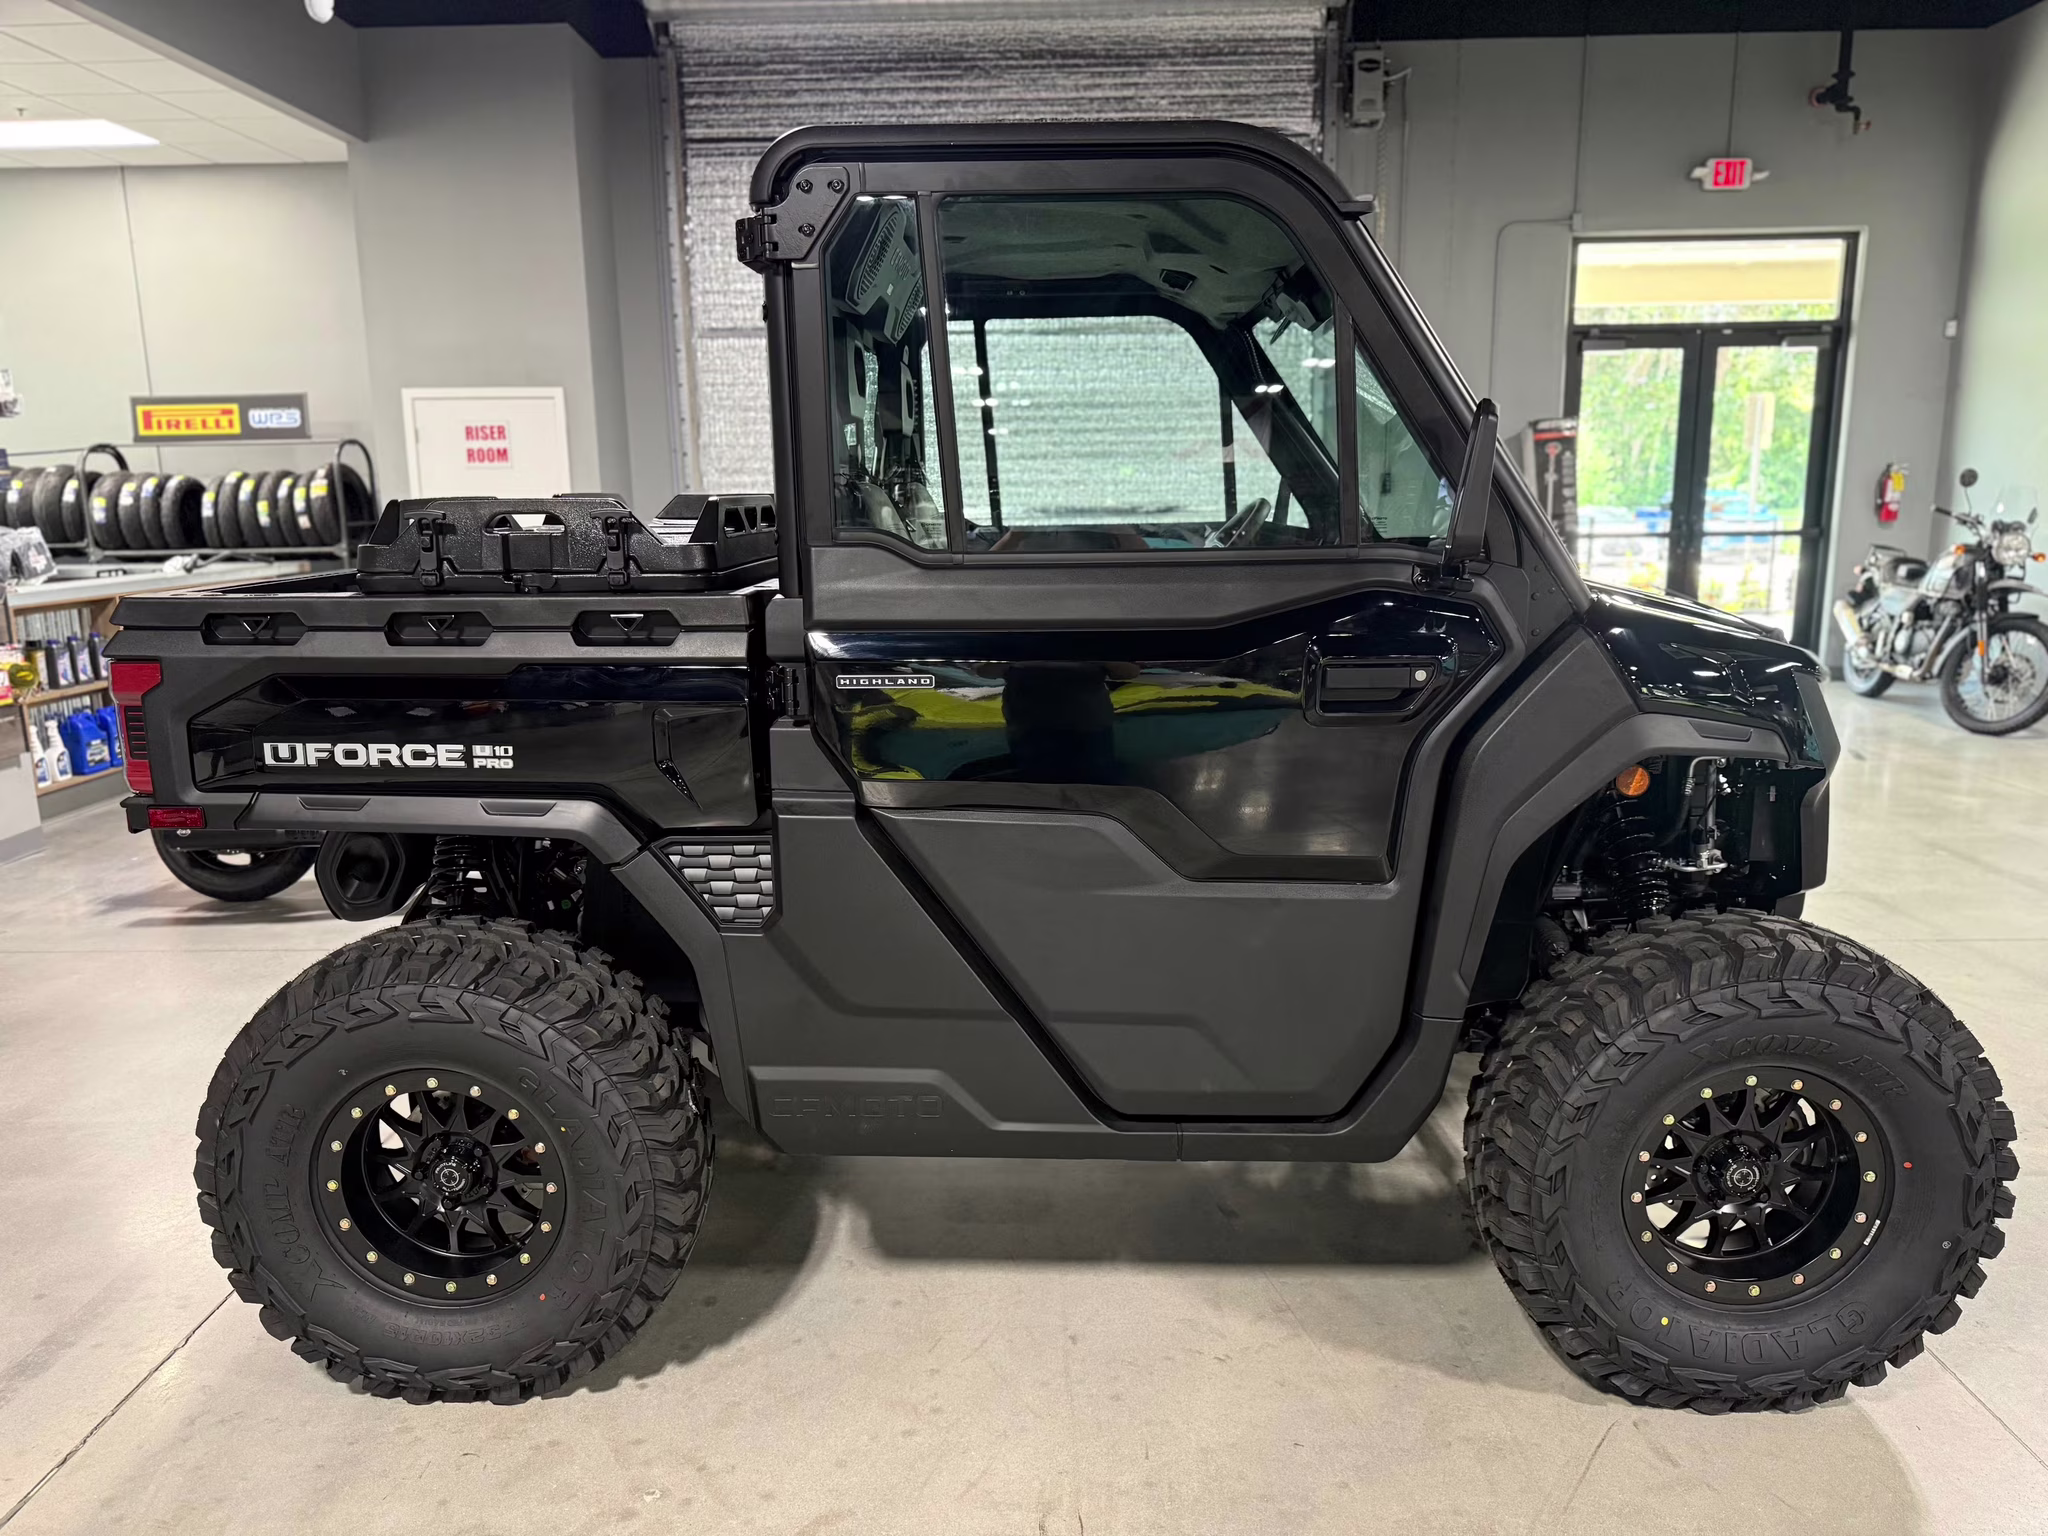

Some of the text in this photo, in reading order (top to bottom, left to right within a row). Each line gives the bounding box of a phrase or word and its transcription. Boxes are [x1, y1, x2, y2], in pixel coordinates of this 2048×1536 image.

[1714, 160, 1745, 186] EXIT
[142, 408, 235, 431] PIRELLI
[465, 425, 507, 441] RISER
[467, 447, 509, 463] ROOM
[473, 757, 514, 769] PRO
[1604, 1280, 1873, 1365] GLADIATOR
